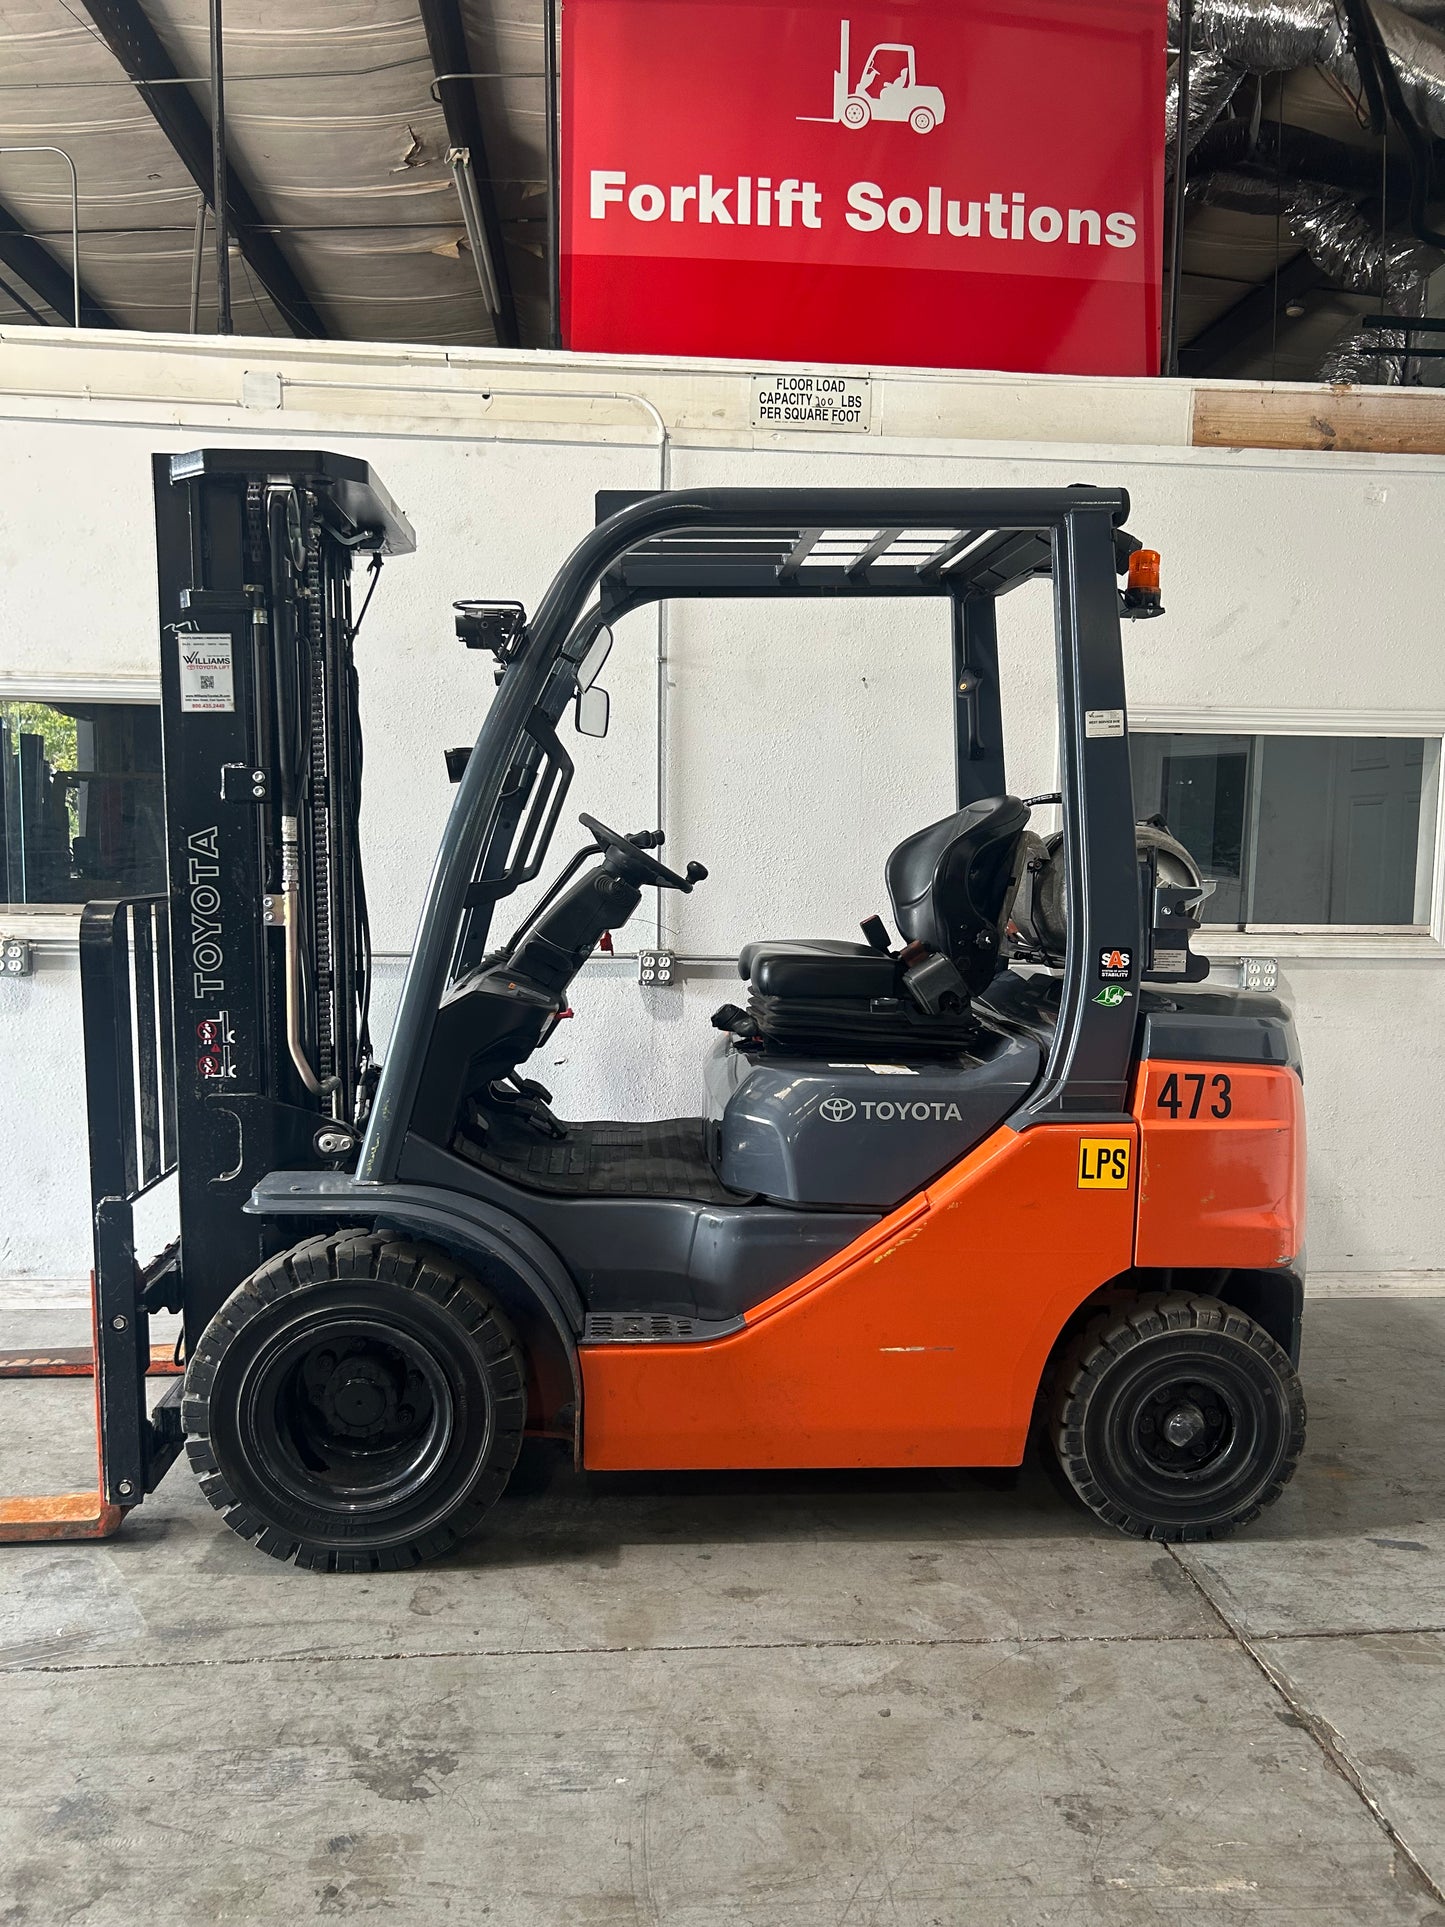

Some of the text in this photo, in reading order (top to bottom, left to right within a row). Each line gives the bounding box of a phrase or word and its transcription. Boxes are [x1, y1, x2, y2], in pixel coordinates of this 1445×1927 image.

[590, 170, 1137, 248] Forklift Solutions
[776, 377, 846, 392] FLOOR LOAD
[759, 391, 813, 406] CAPACITY
[841, 395, 862, 408] LBS
[760, 406, 861, 423] PER SQUARE FOOT
[182, 651, 230, 664] WILLIAMS
[188, 825, 224, 999] TOYOTA
[1101, 950, 1130, 968] SAS
[1157, 1073, 1232, 1119] 473
[860, 1101, 963, 1121] TOYOTA
[1081, 1148, 1127, 1180] LPS
